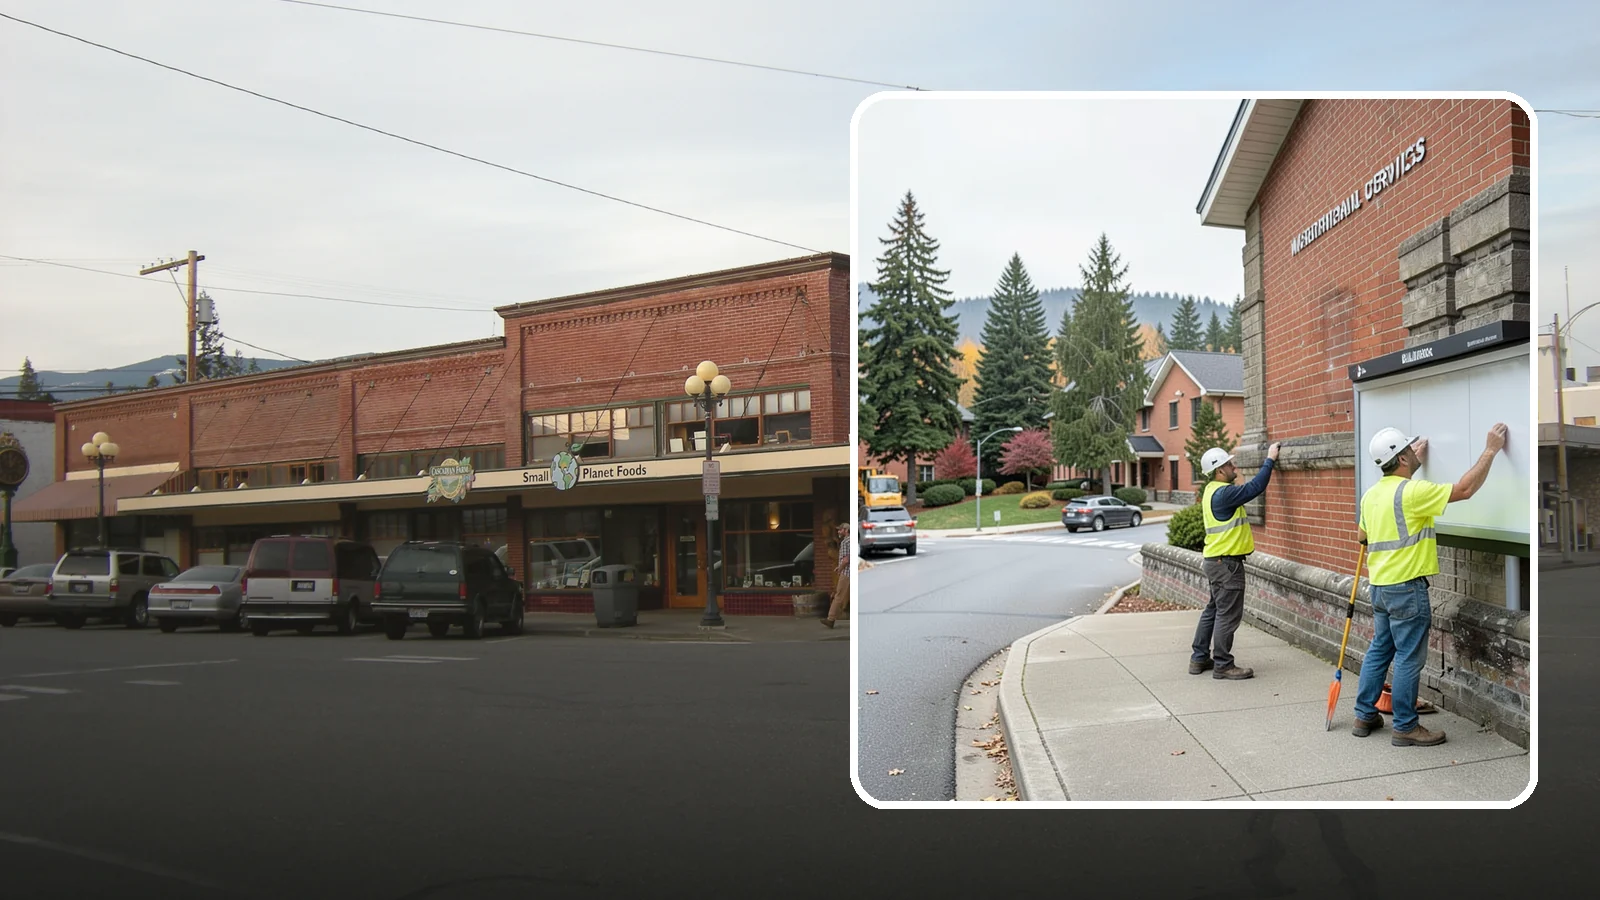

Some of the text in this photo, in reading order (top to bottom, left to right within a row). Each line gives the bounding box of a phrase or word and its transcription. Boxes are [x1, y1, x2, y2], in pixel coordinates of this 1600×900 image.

[523, 465, 647, 483] Small Planet Foods
